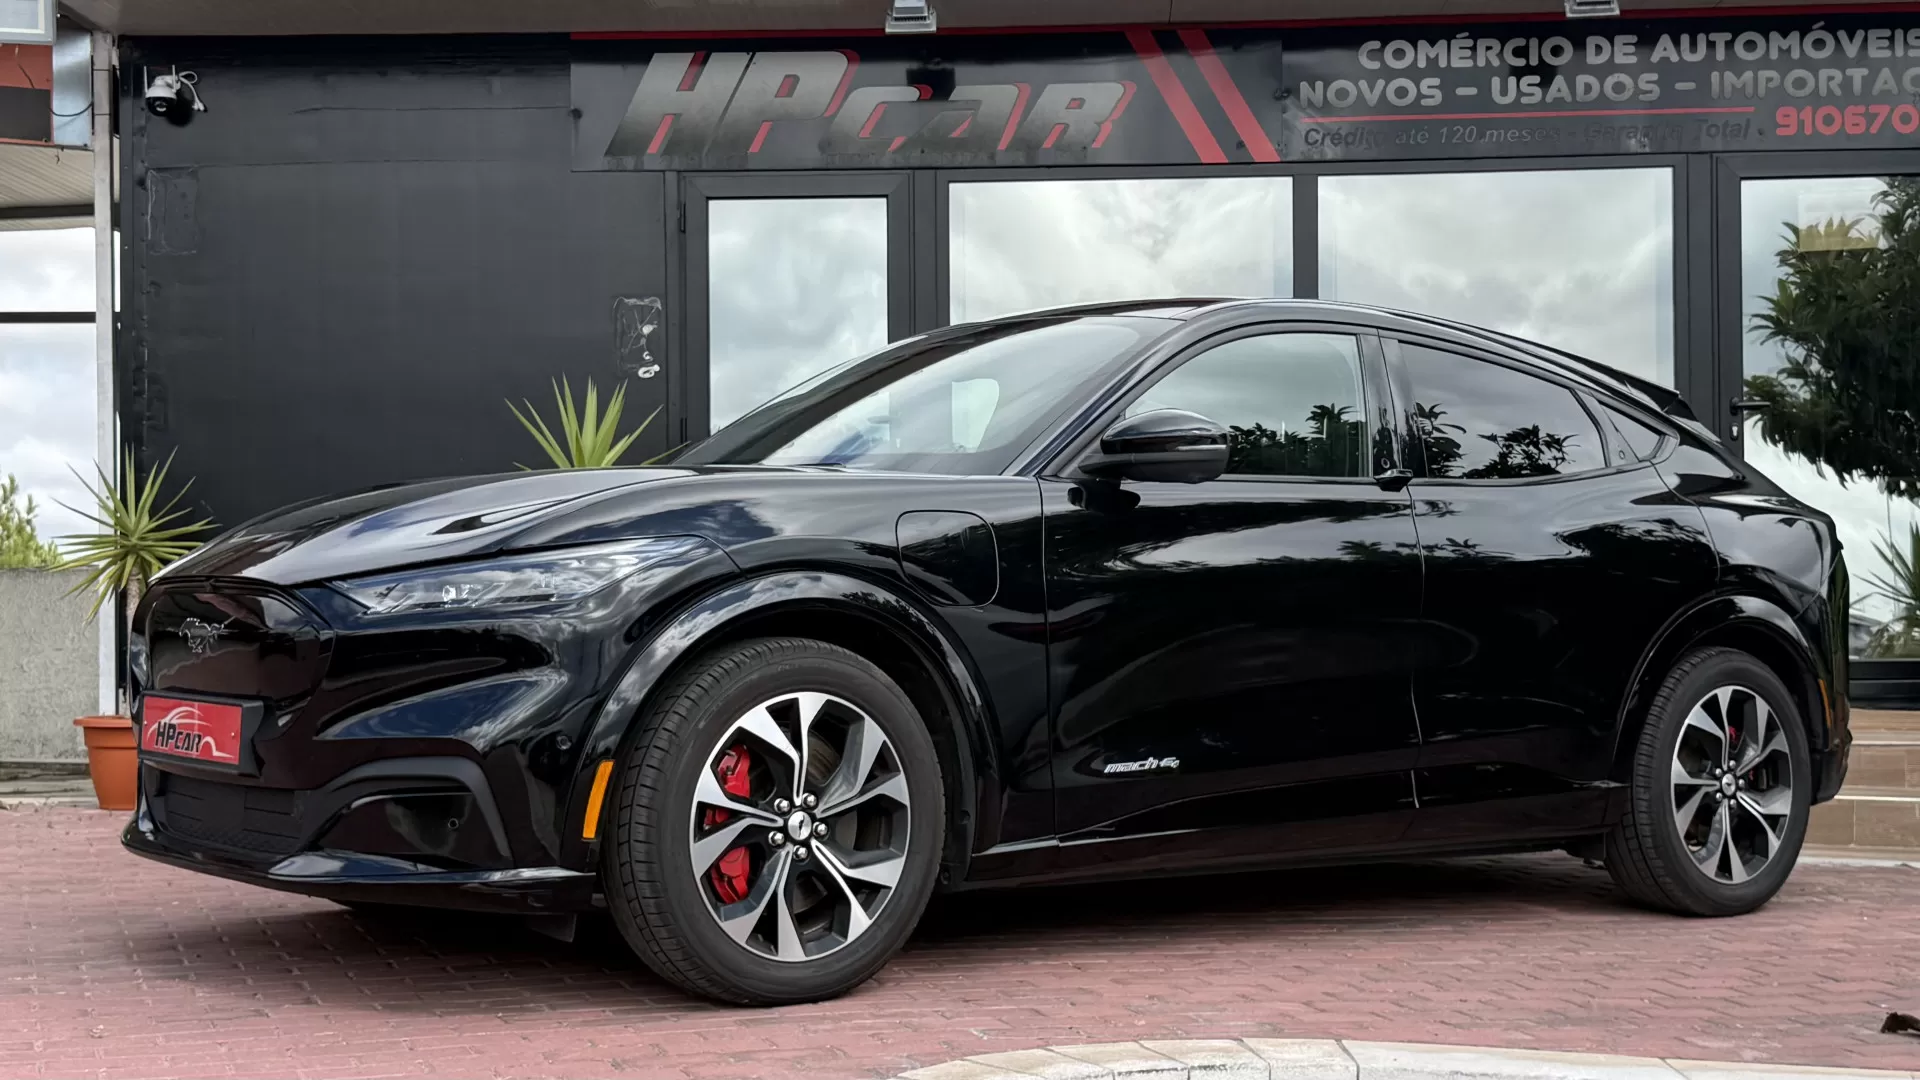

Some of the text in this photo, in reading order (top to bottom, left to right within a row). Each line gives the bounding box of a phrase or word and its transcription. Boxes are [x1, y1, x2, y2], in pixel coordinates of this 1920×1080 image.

[1358, 21, 1920, 69] COMÉRCIO DE AUTOMÓVEIS
[1300, 77, 1443, 109] NOVOS
[1491, 73, 1661, 104] USADOS
[1396, 125, 1429, 145] até
[1776, 104, 1919, 136] 910670
